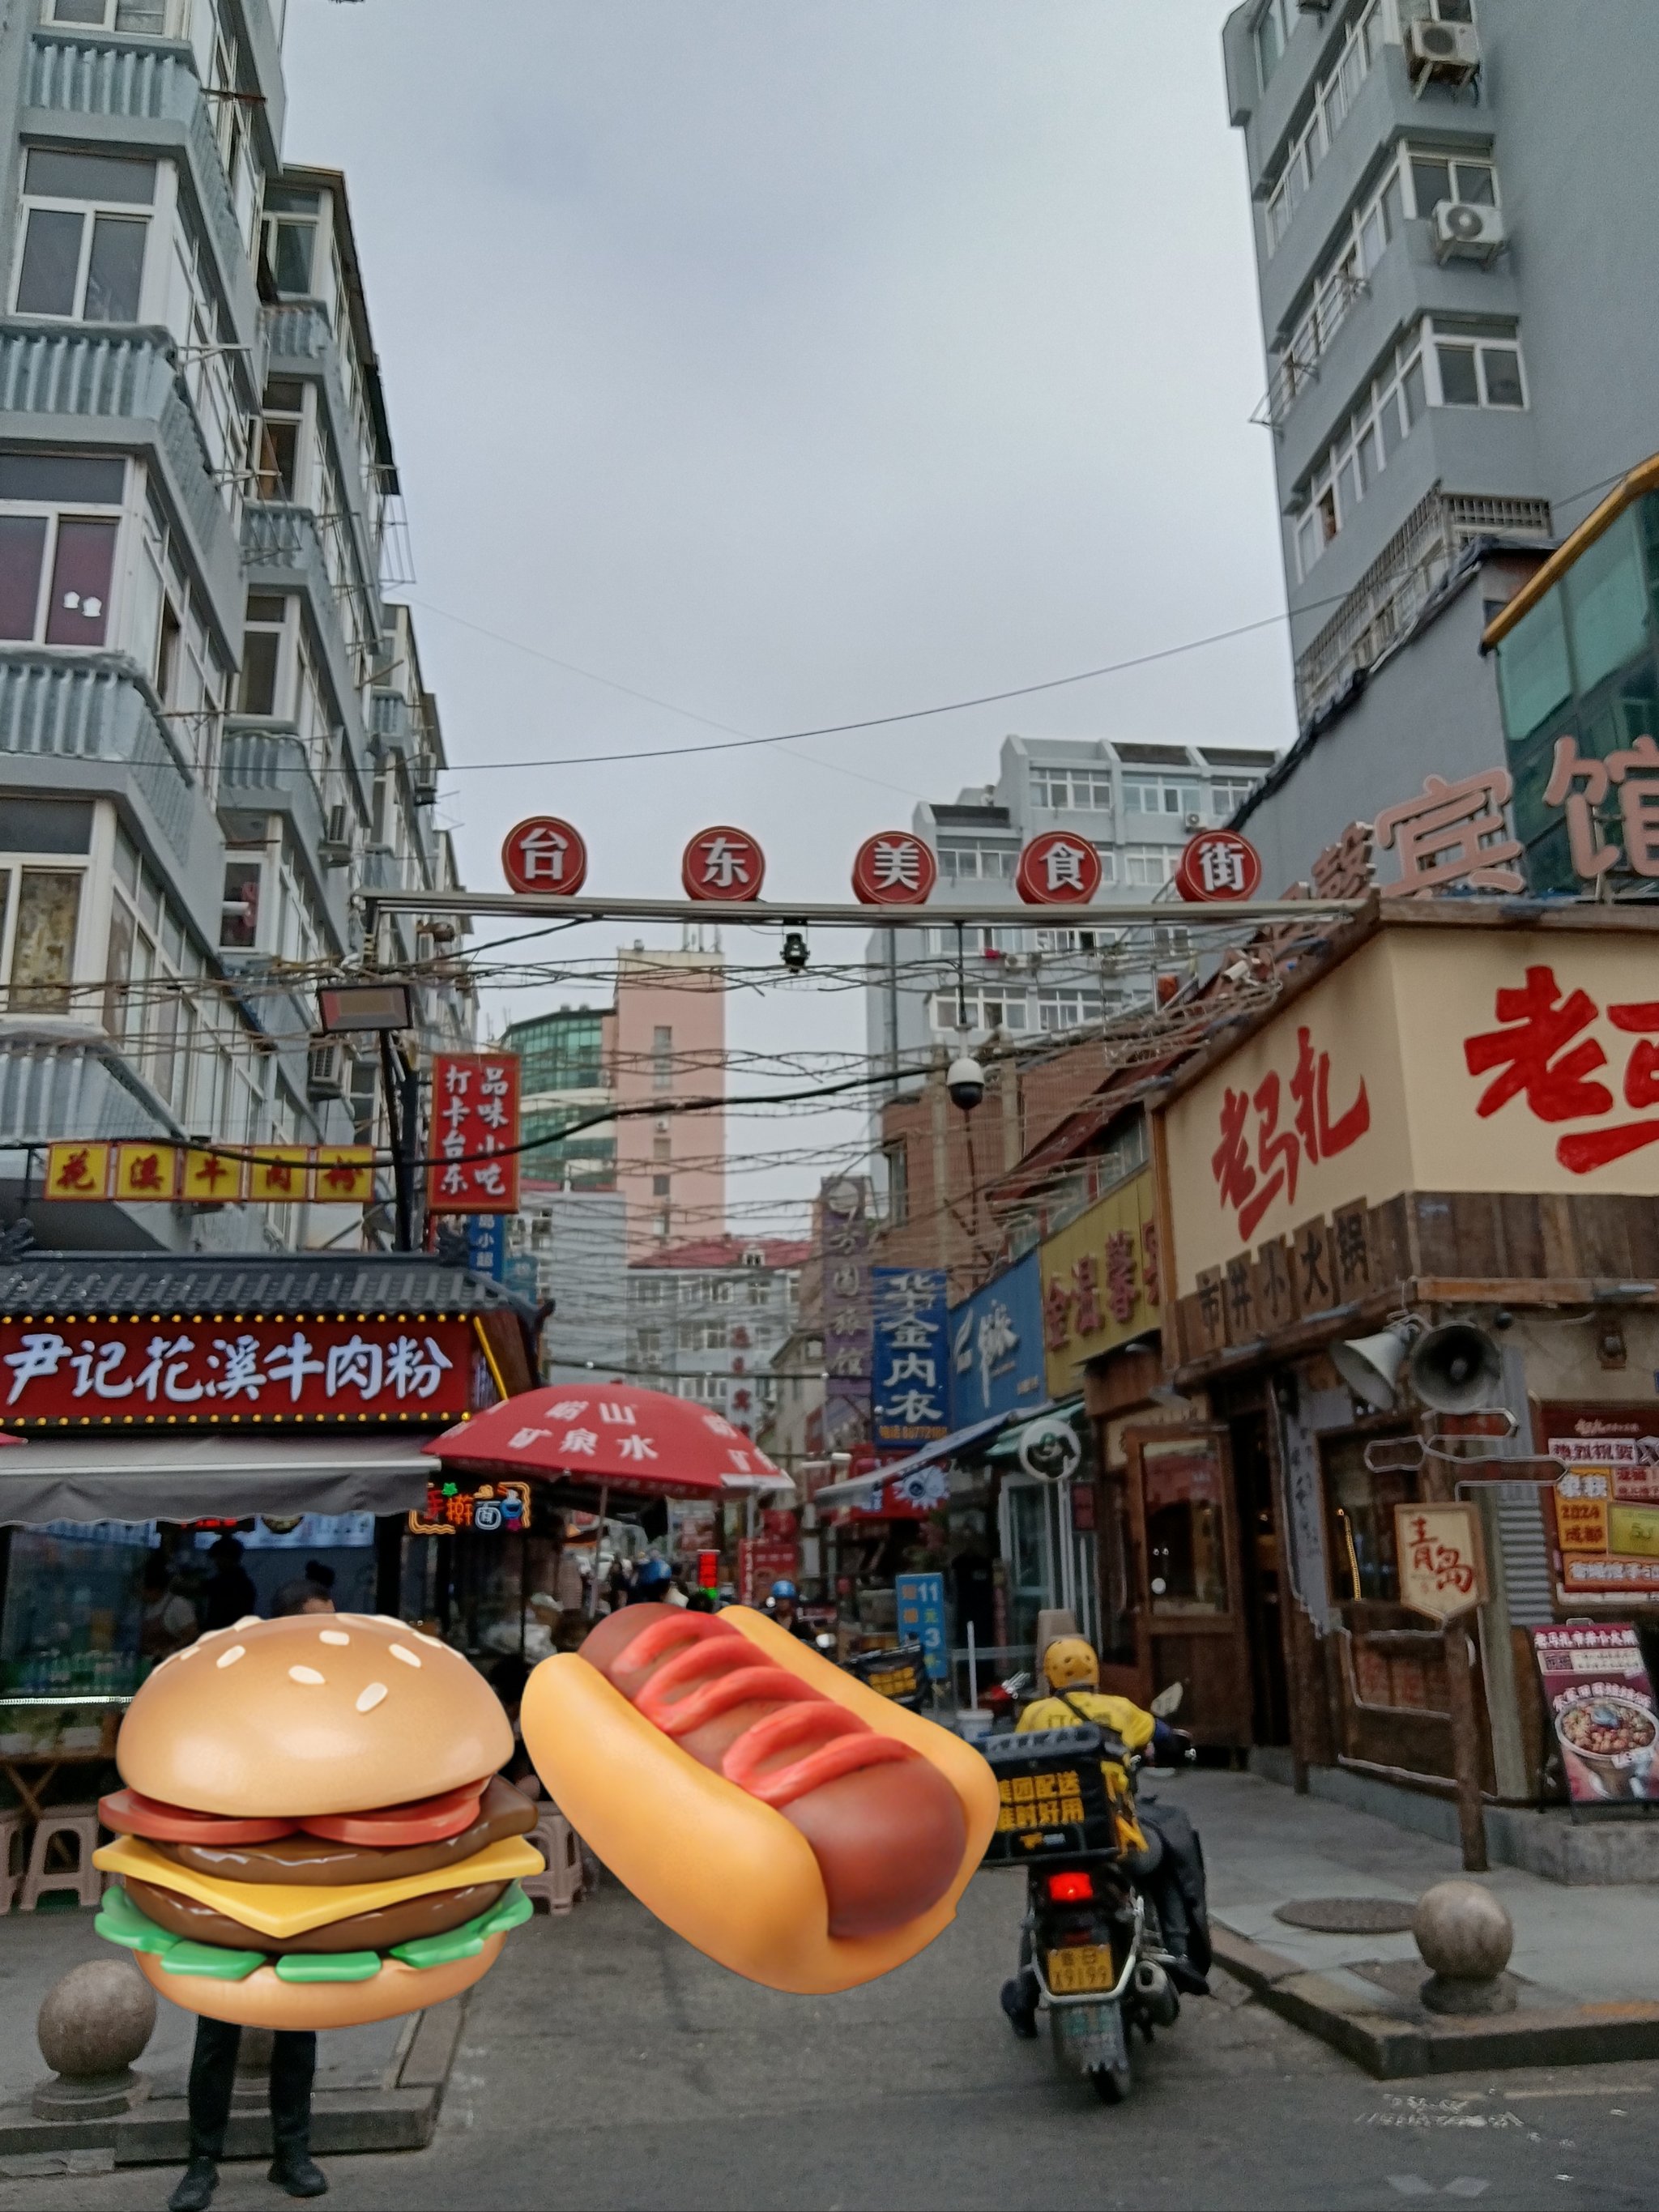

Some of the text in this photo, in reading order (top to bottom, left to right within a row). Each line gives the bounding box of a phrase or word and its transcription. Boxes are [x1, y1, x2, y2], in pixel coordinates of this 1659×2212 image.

[519, 826, 1247, 892] 台东美食街
[441, 1064, 471, 1195] 打卡台东
[475, 1067, 509, 1196] 品味小吃
[1212, 1026, 1371, 1242] 老马扎
[56, 1152, 365, 1192] 花溪牛肉粉
[3, 1331, 454, 1406] 尹记花溪牛肉粉
[508, 1427, 659, 1460] 矿泉水
[1409, 1517, 1473, 1593] 青岛
